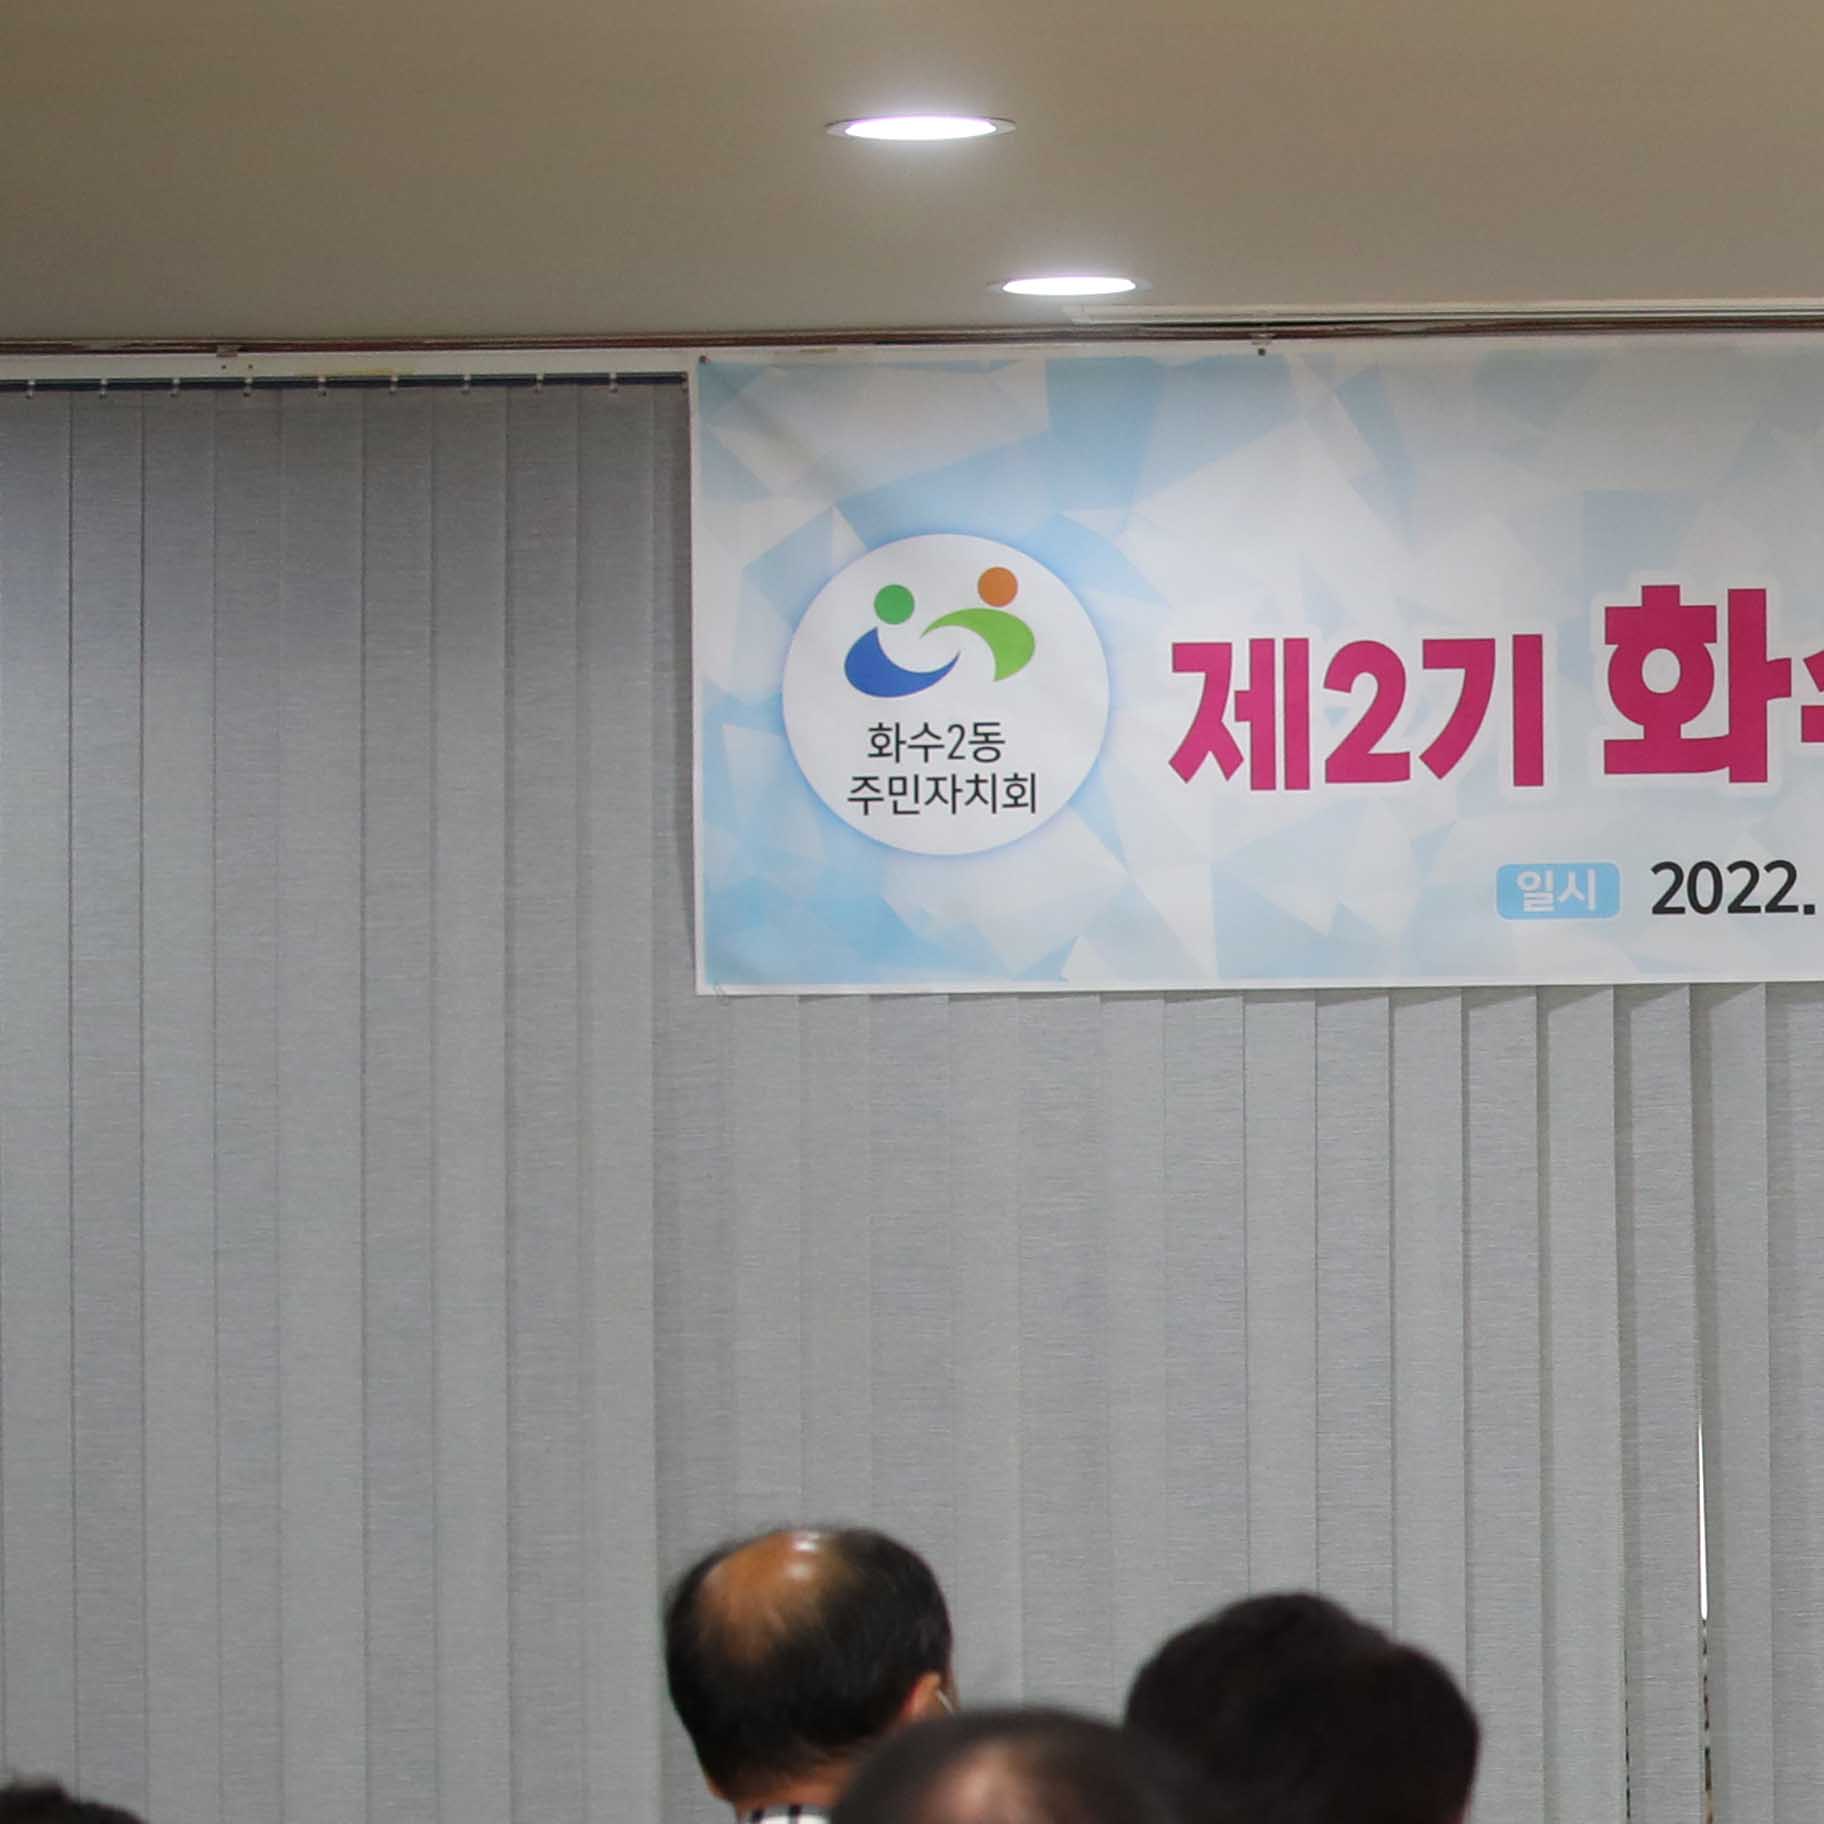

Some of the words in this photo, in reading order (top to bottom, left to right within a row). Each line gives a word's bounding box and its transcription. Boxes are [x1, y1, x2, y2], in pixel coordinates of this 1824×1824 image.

[1167, 632, 1546, 792] 제2기
[866, 721, 1006, 765] 화수2동
[846, 771, 1037, 817] 주민자치회
[1515, 868, 1597, 913] 일시
[1649, 858, 1817, 917] 2022.
